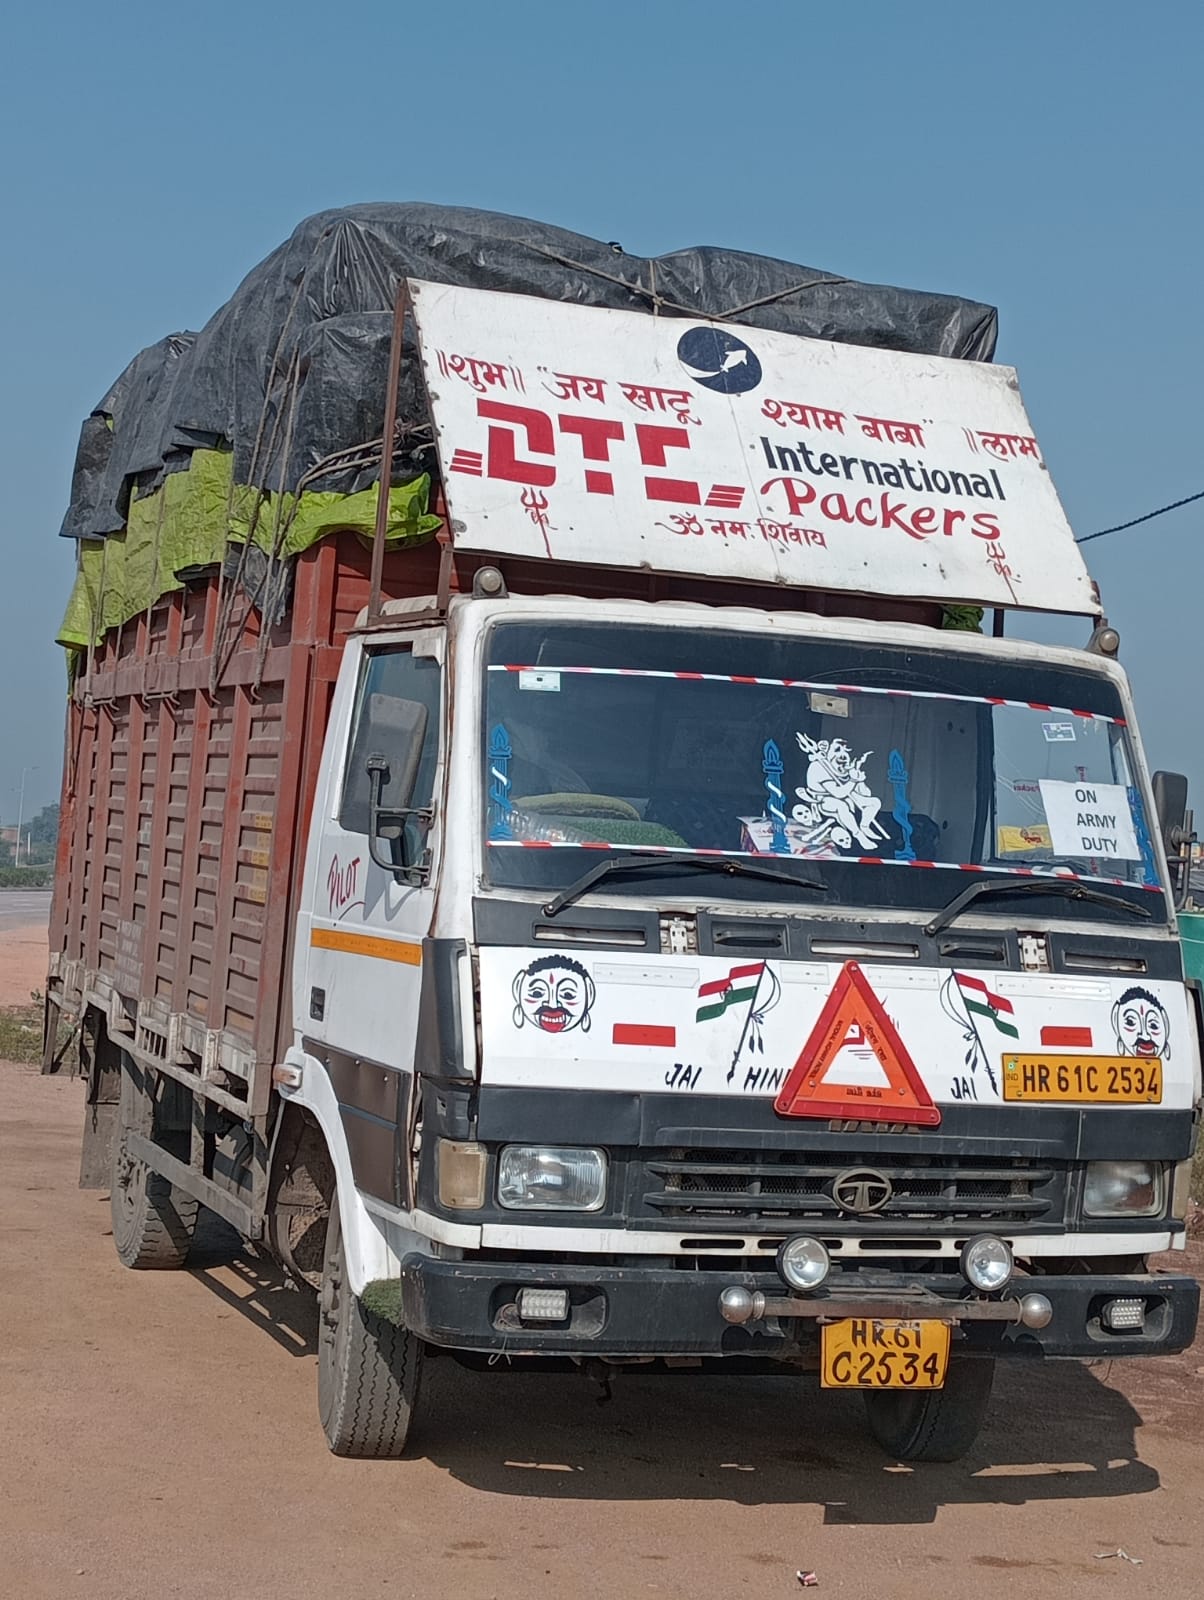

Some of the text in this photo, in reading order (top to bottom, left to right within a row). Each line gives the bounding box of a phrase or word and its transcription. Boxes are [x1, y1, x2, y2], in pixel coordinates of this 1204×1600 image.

[760, 398, 846, 434] श्याम
[760, 436, 1007, 501] International
[760, 476, 1001, 541] Packers
[1075, 789, 1097, 803] ON
[1076, 813, 1116, 829] ARMY
[1081, 837, 1117, 852] DUTY
[326, 853, 361, 914] PILOT
[665, 1063, 702, 1091] JAI
[951, 1077, 978, 1101] JAI
[1107, 1066, 1159, 1095] 2534
